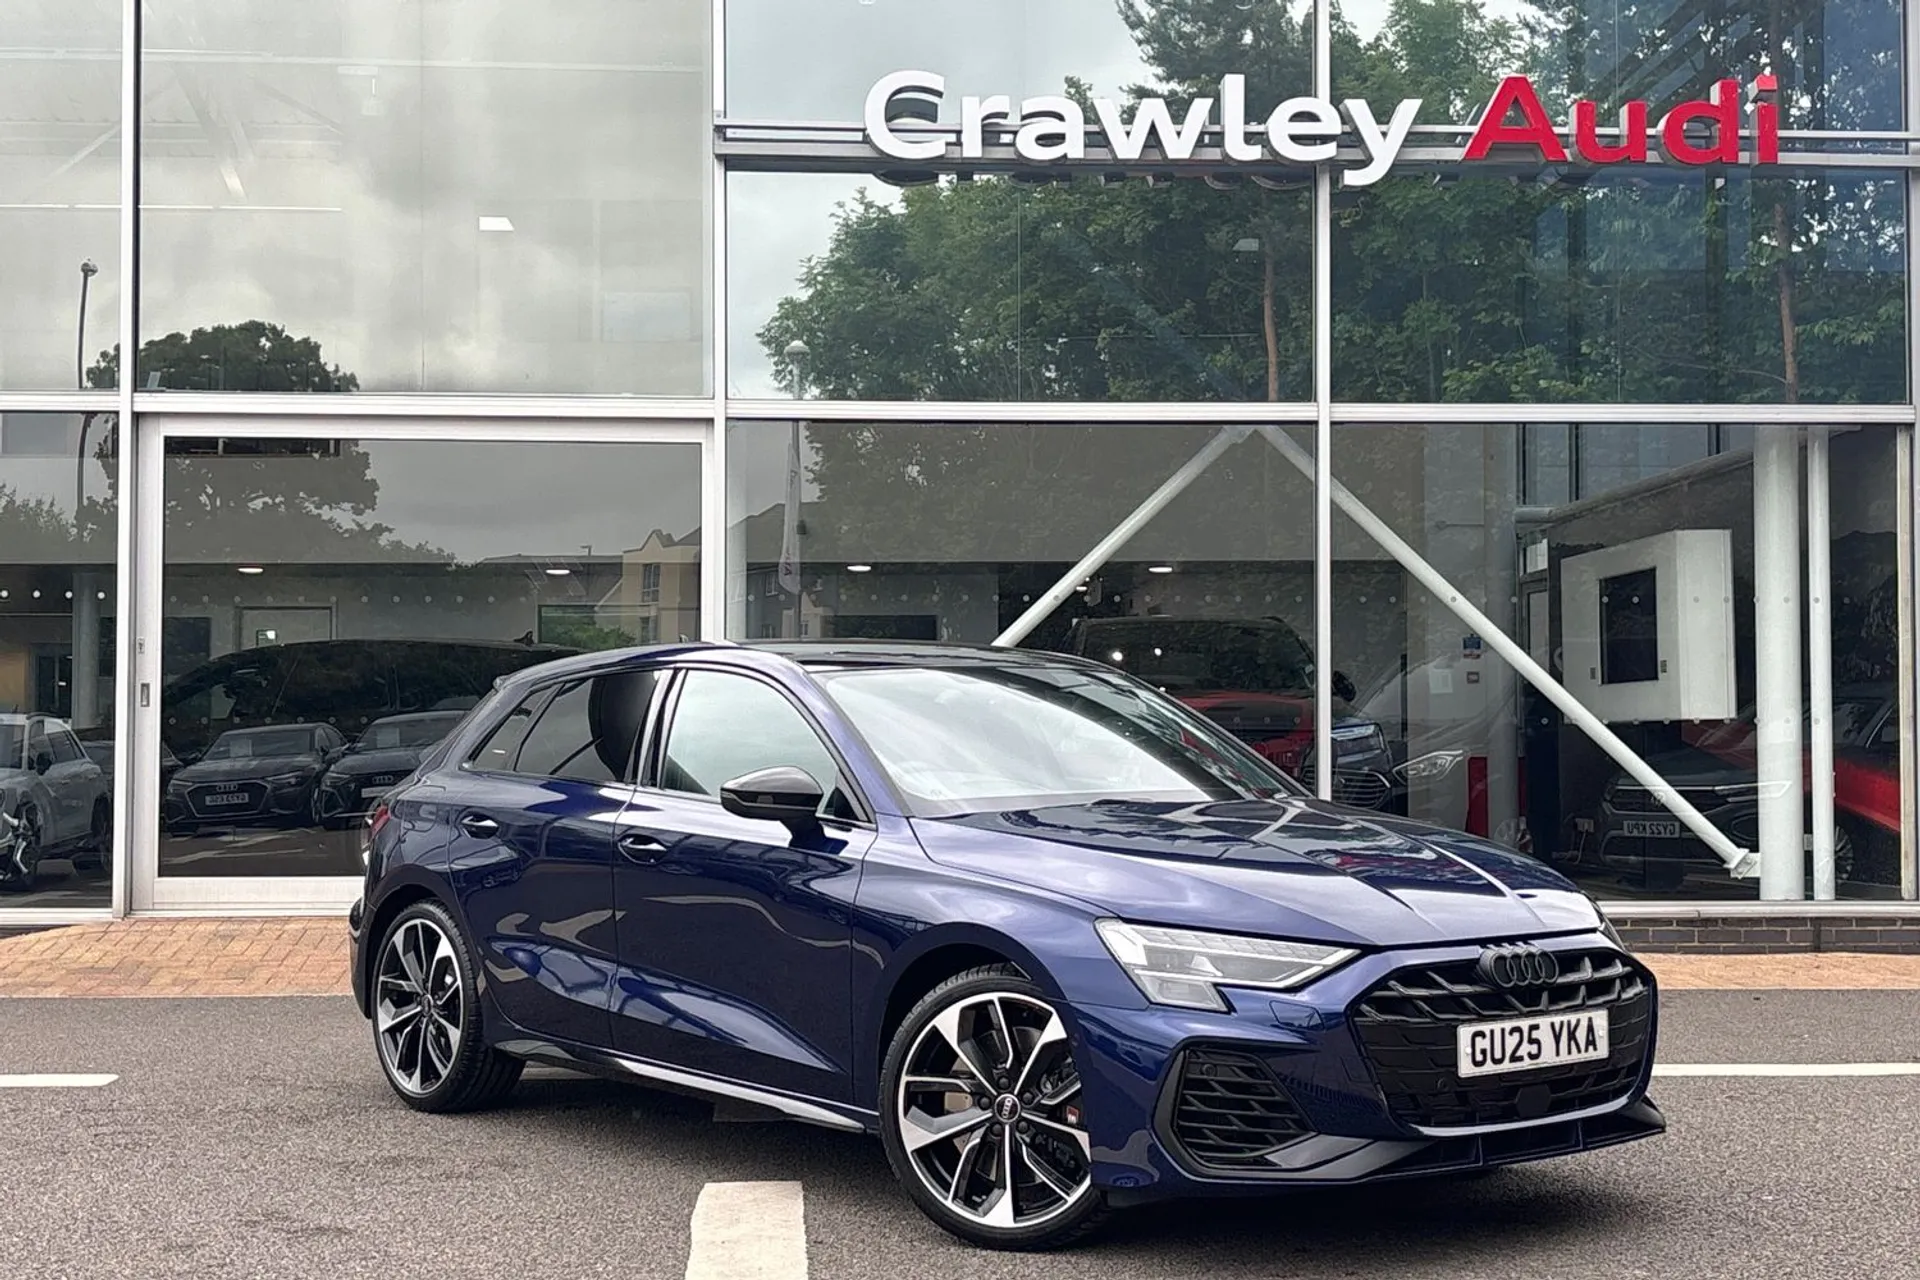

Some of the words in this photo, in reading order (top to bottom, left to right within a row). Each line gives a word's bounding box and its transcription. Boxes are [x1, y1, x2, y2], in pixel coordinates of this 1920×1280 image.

[863, 70, 1423, 187] Crawley
[1459, 73, 1779, 166] Audi
[1470, 1023, 1542, 1068] GU25
[1550, 1016, 1598, 1058] YKA
